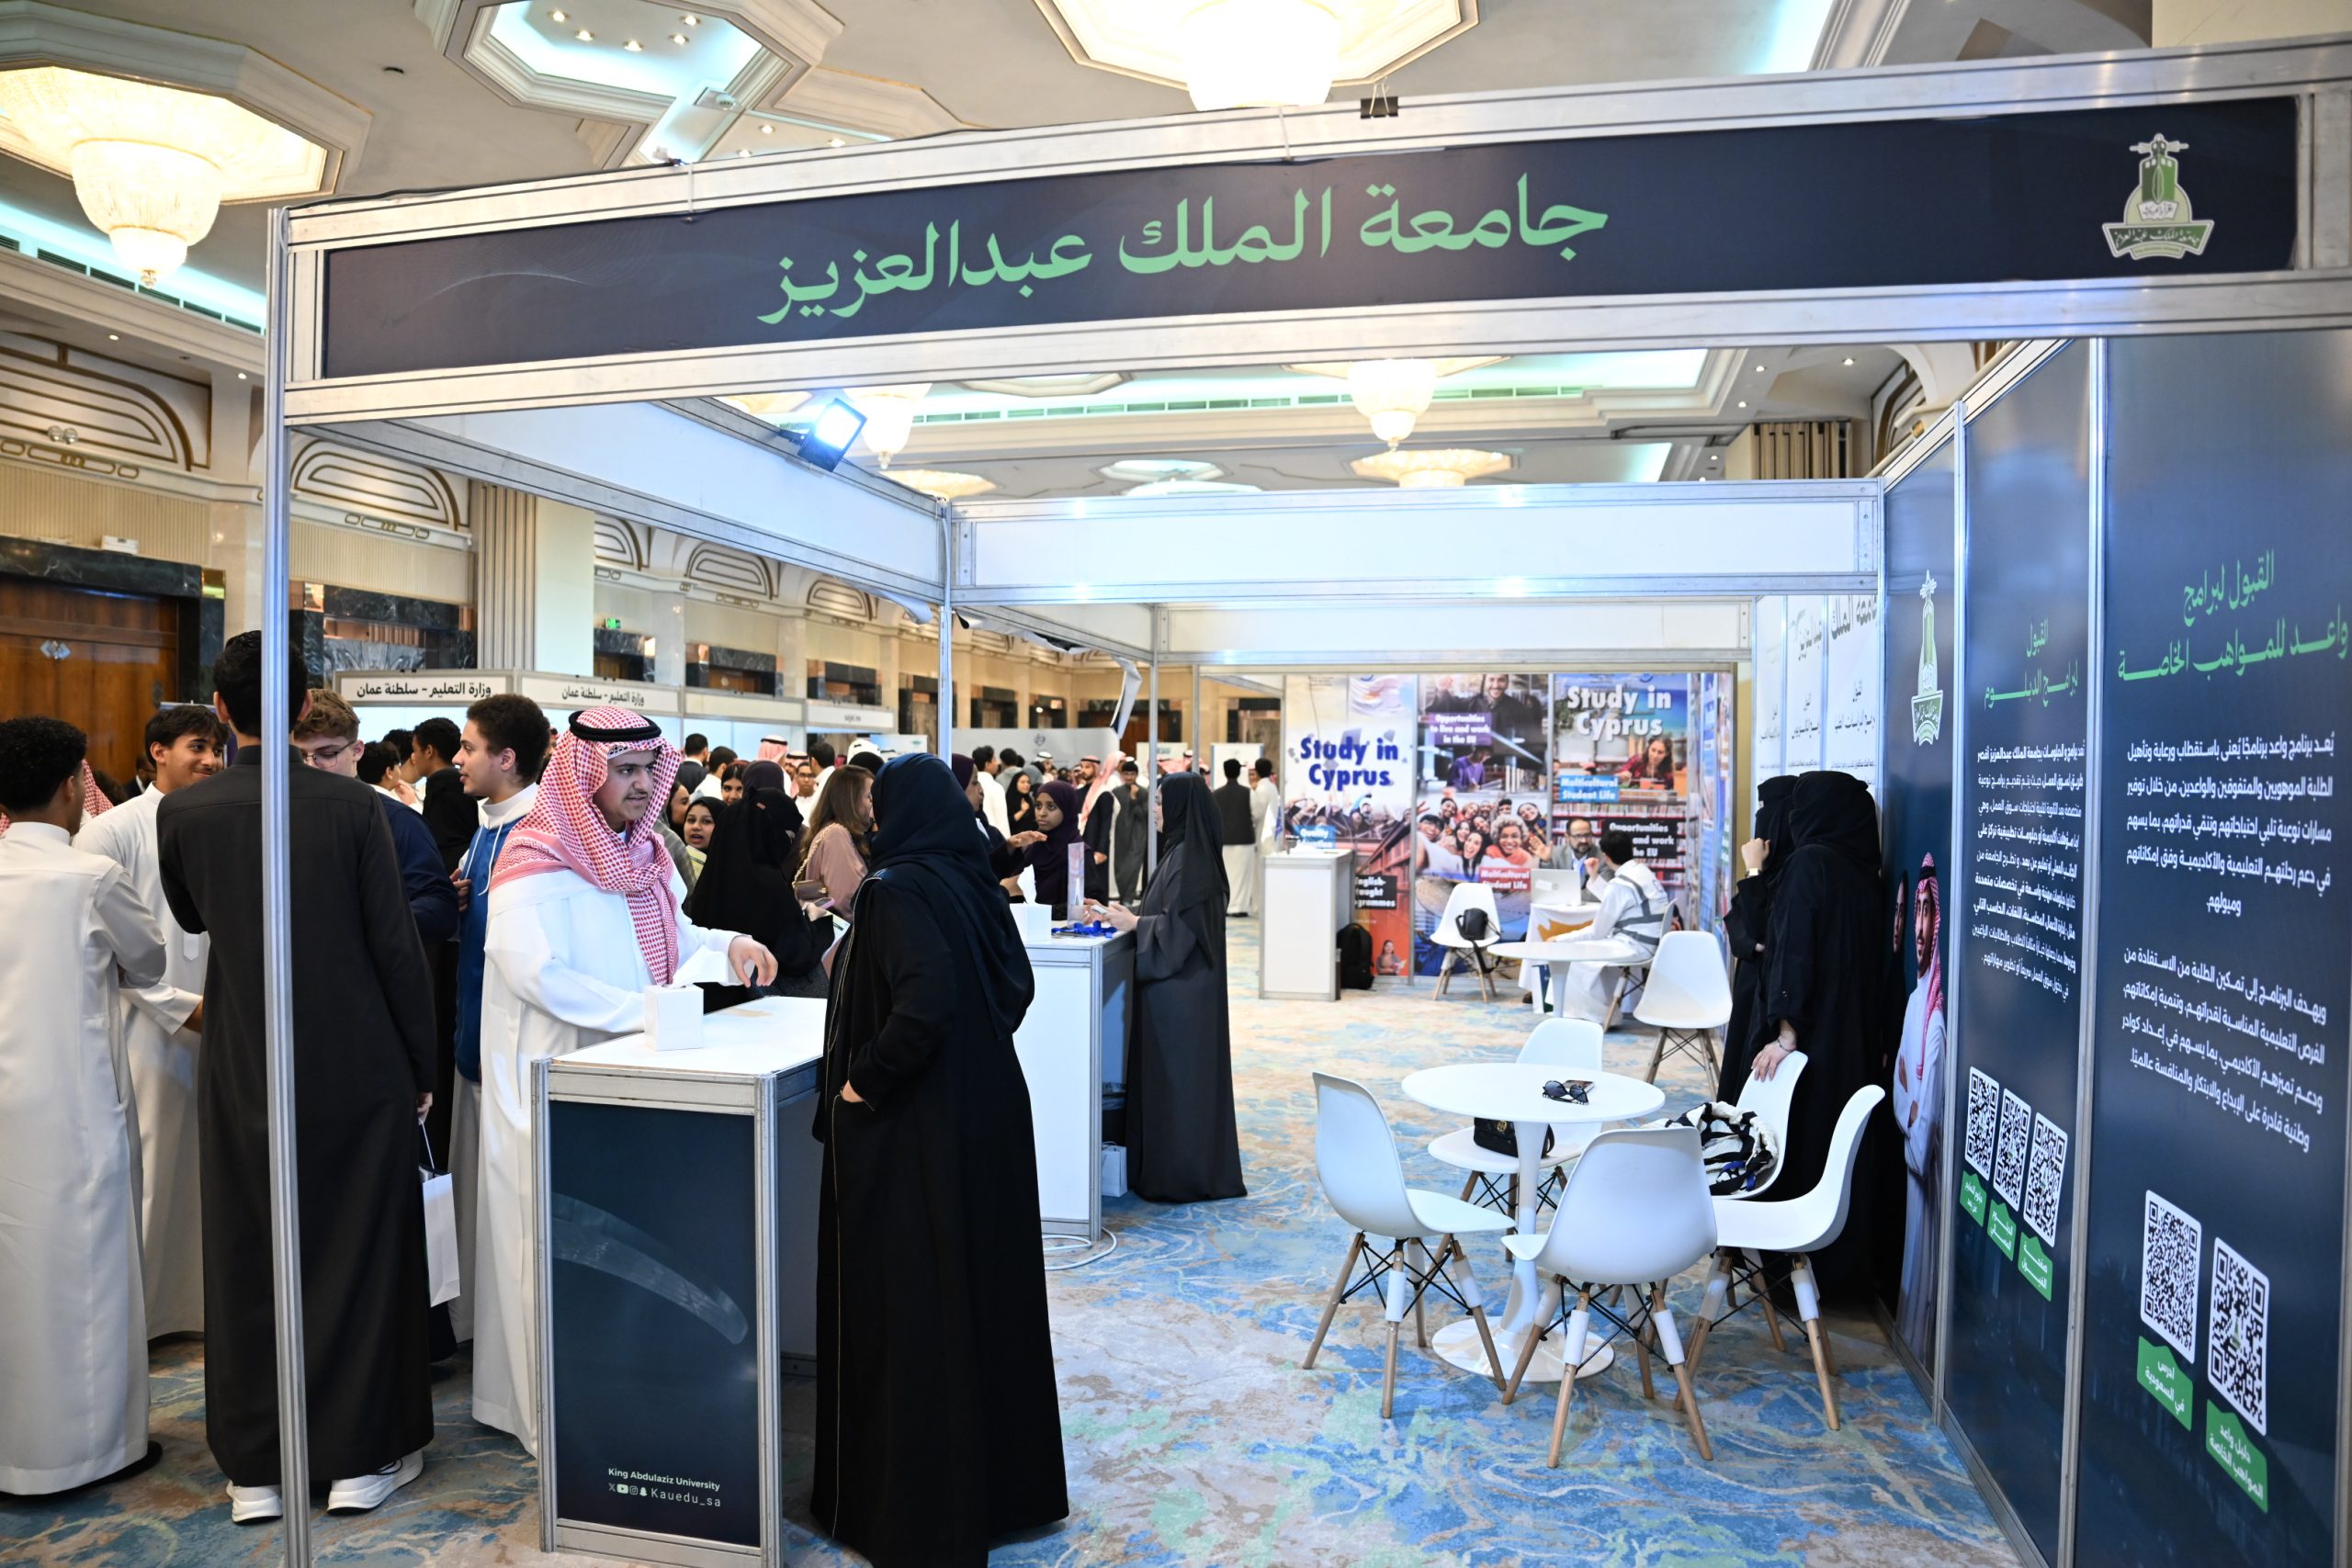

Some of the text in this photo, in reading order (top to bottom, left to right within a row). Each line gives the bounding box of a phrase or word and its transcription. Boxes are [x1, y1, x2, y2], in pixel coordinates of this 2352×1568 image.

[756, 172, 1609, 325] جامعة الملك عبدالعزيز
[2183, 547, 2275, 627] القبول لبرامج
[2118, 603, 2349, 682] واعد للمواهب الخاصة
[356, 682, 492, 699] وزارة التعليم سلطنة عمان
[561, 685, 645, 707] وزارة التعليم سلطنة عمان
[1567, 684, 1671, 715] Study in
[1435, 714, 1486, 724] Opportunities
[1439, 724, 1453, 733] live
[1454, 724, 1469, 733] and
[1470, 724, 1490, 733] work
[1577, 712, 1662, 742] Cyprus
[1300, 736, 1398, 765] Study in
[1442, 735, 1476, 743] in the EU
[2127, 739, 2153, 762] وتأهيل
[2177, 739, 2220, 762] باستقطاب
[2269, 735, 2288, 760] واعد
[2289, 733, 2312, 761] برنامج
[2153, 741, 2176, 762] ورعاية
[1308, 763, 1390, 791] Cyprus
[1561, 777, 1619, 787] Multicultural
[2126, 776, 2146, 796] توفير
[2146, 776, 2164, 796] خلال
[2164, 780, 2177, 797] من
[2217, 775, 2263, 800] والمتفوقين
[2264, 775, 2306, 802] الموهوبين
[2307, 775, 2333, 802] الطلبة
[1562, 790, 1616, 799] Student Life
[2126, 815, 2149, 831] يسهم
[2149, 810, 2161, 832] بما
[2218, 815, 2258, 839] احتياجاتهم
[2258, 817, 2278, 847] تلبي
[2278, 818, 2301, 844] نوعية
[2301, 819, 2332, 846] مسارات
[1300, 828, 1329, 839] Quality
[1632, 835, 1675, 845] and work
[1633, 847, 1658, 857] he EU
[2126, 844, 2331, 898] في دعم رحلتهم التعليمية والأكاديمية وفق إمكاناتهم
[2124, 947, 2137, 964] من
[2138, 947, 2177, 973] الاستفادة
[2177, 961, 2190, 978] من
[2192, 962, 2215, 984] الطلبة
[2216, 971, 2245, 992] تمكين
[2245, 977, 2258, 1002] إلى
[2258, 984, 2292, 1011] البرنامج
[2159, 992, 2184, 1014] وتنمية
[2121, 1012, 2141, 1034] كوادر
[2142, 1017, 2165, 1045] إعداد
[2222, 1009, 2259, 1038] المناسبة
[2165, 1029, 2178, 1053] في
[2178, 1036, 2206, 1058] يسهم
[2259, 1021, 2297, 1054] التعليمية
[2206, 1040, 2218, 1065] بما
[2298, 1043, 2325, 1066] الفرص
[2155, 1056, 2193, 1092] والمنافسة
[2261, 1068, 2294, 1096] تميزهم
[2193, 1073, 2222, 1106] والابتكار
[2294, 1086, 2324, 1115] ودعم
[2245, 1100, 2260, 1122] على
[2262, 1106, 2282, 1134] قادرة
[2283, 1118, 2310, 1154] وطنية
[2144, 1366, 2185, 1415] في السعودية
[608, 1468, 720, 1492] King Abdulaziz University
